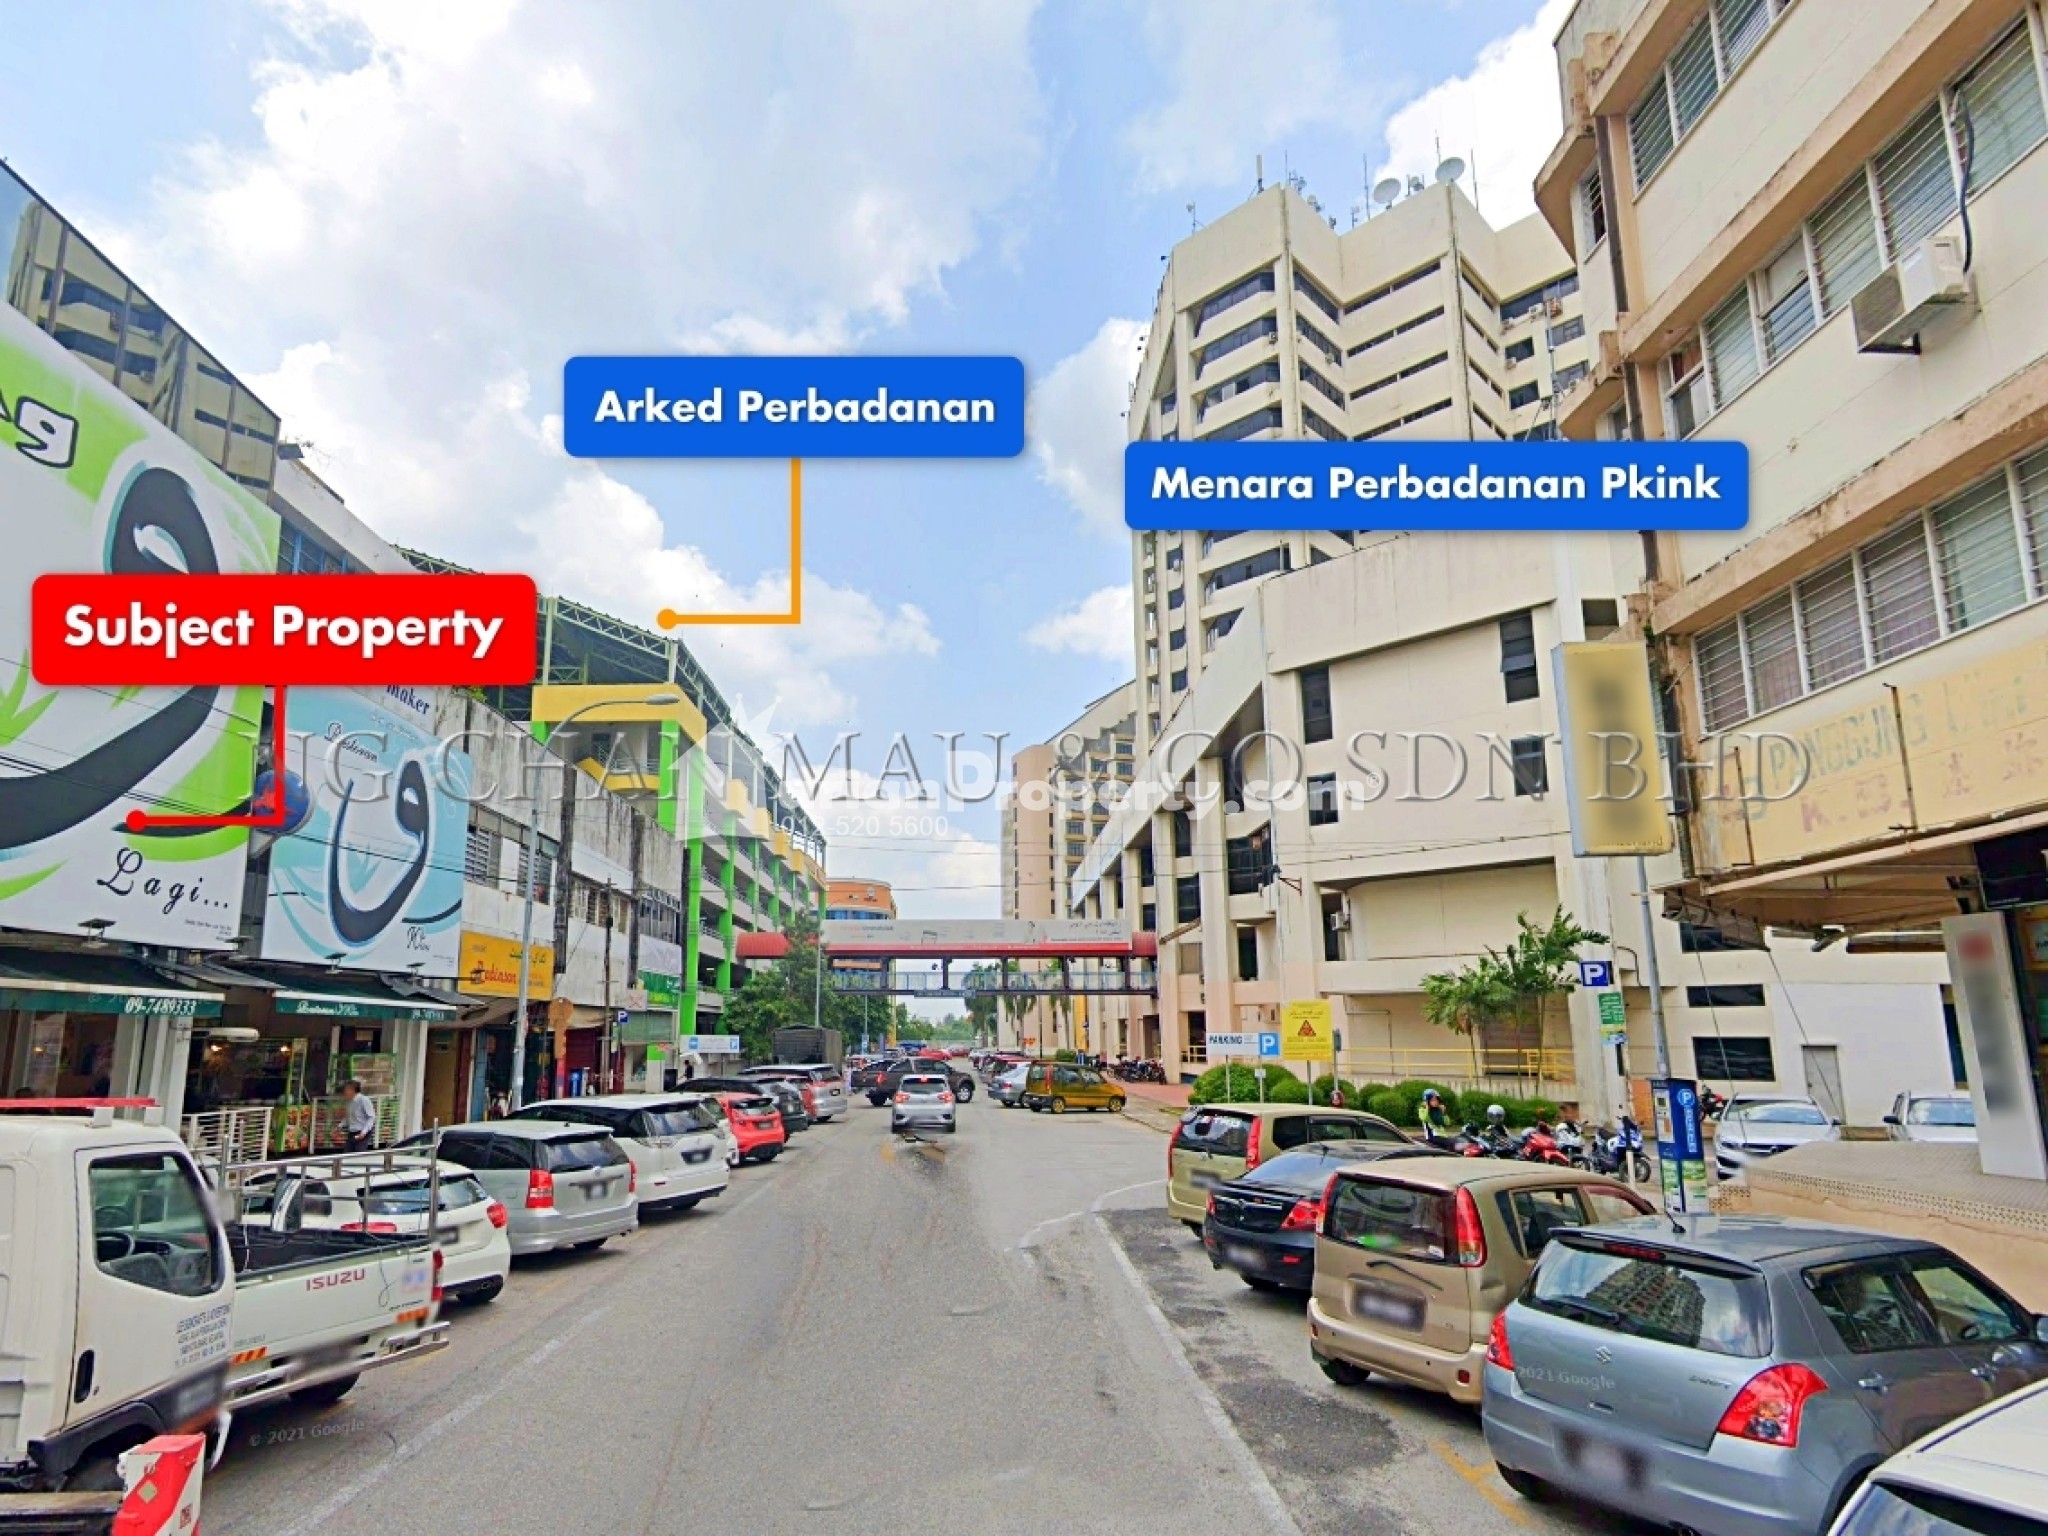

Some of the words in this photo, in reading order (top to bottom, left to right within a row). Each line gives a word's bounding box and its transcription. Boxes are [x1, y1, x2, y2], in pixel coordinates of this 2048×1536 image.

[1583, 963, 1604, 985] P
[1208, 1035, 1243, 1045] PARKING
[306, 1268, 365, 1292] ISUZU
